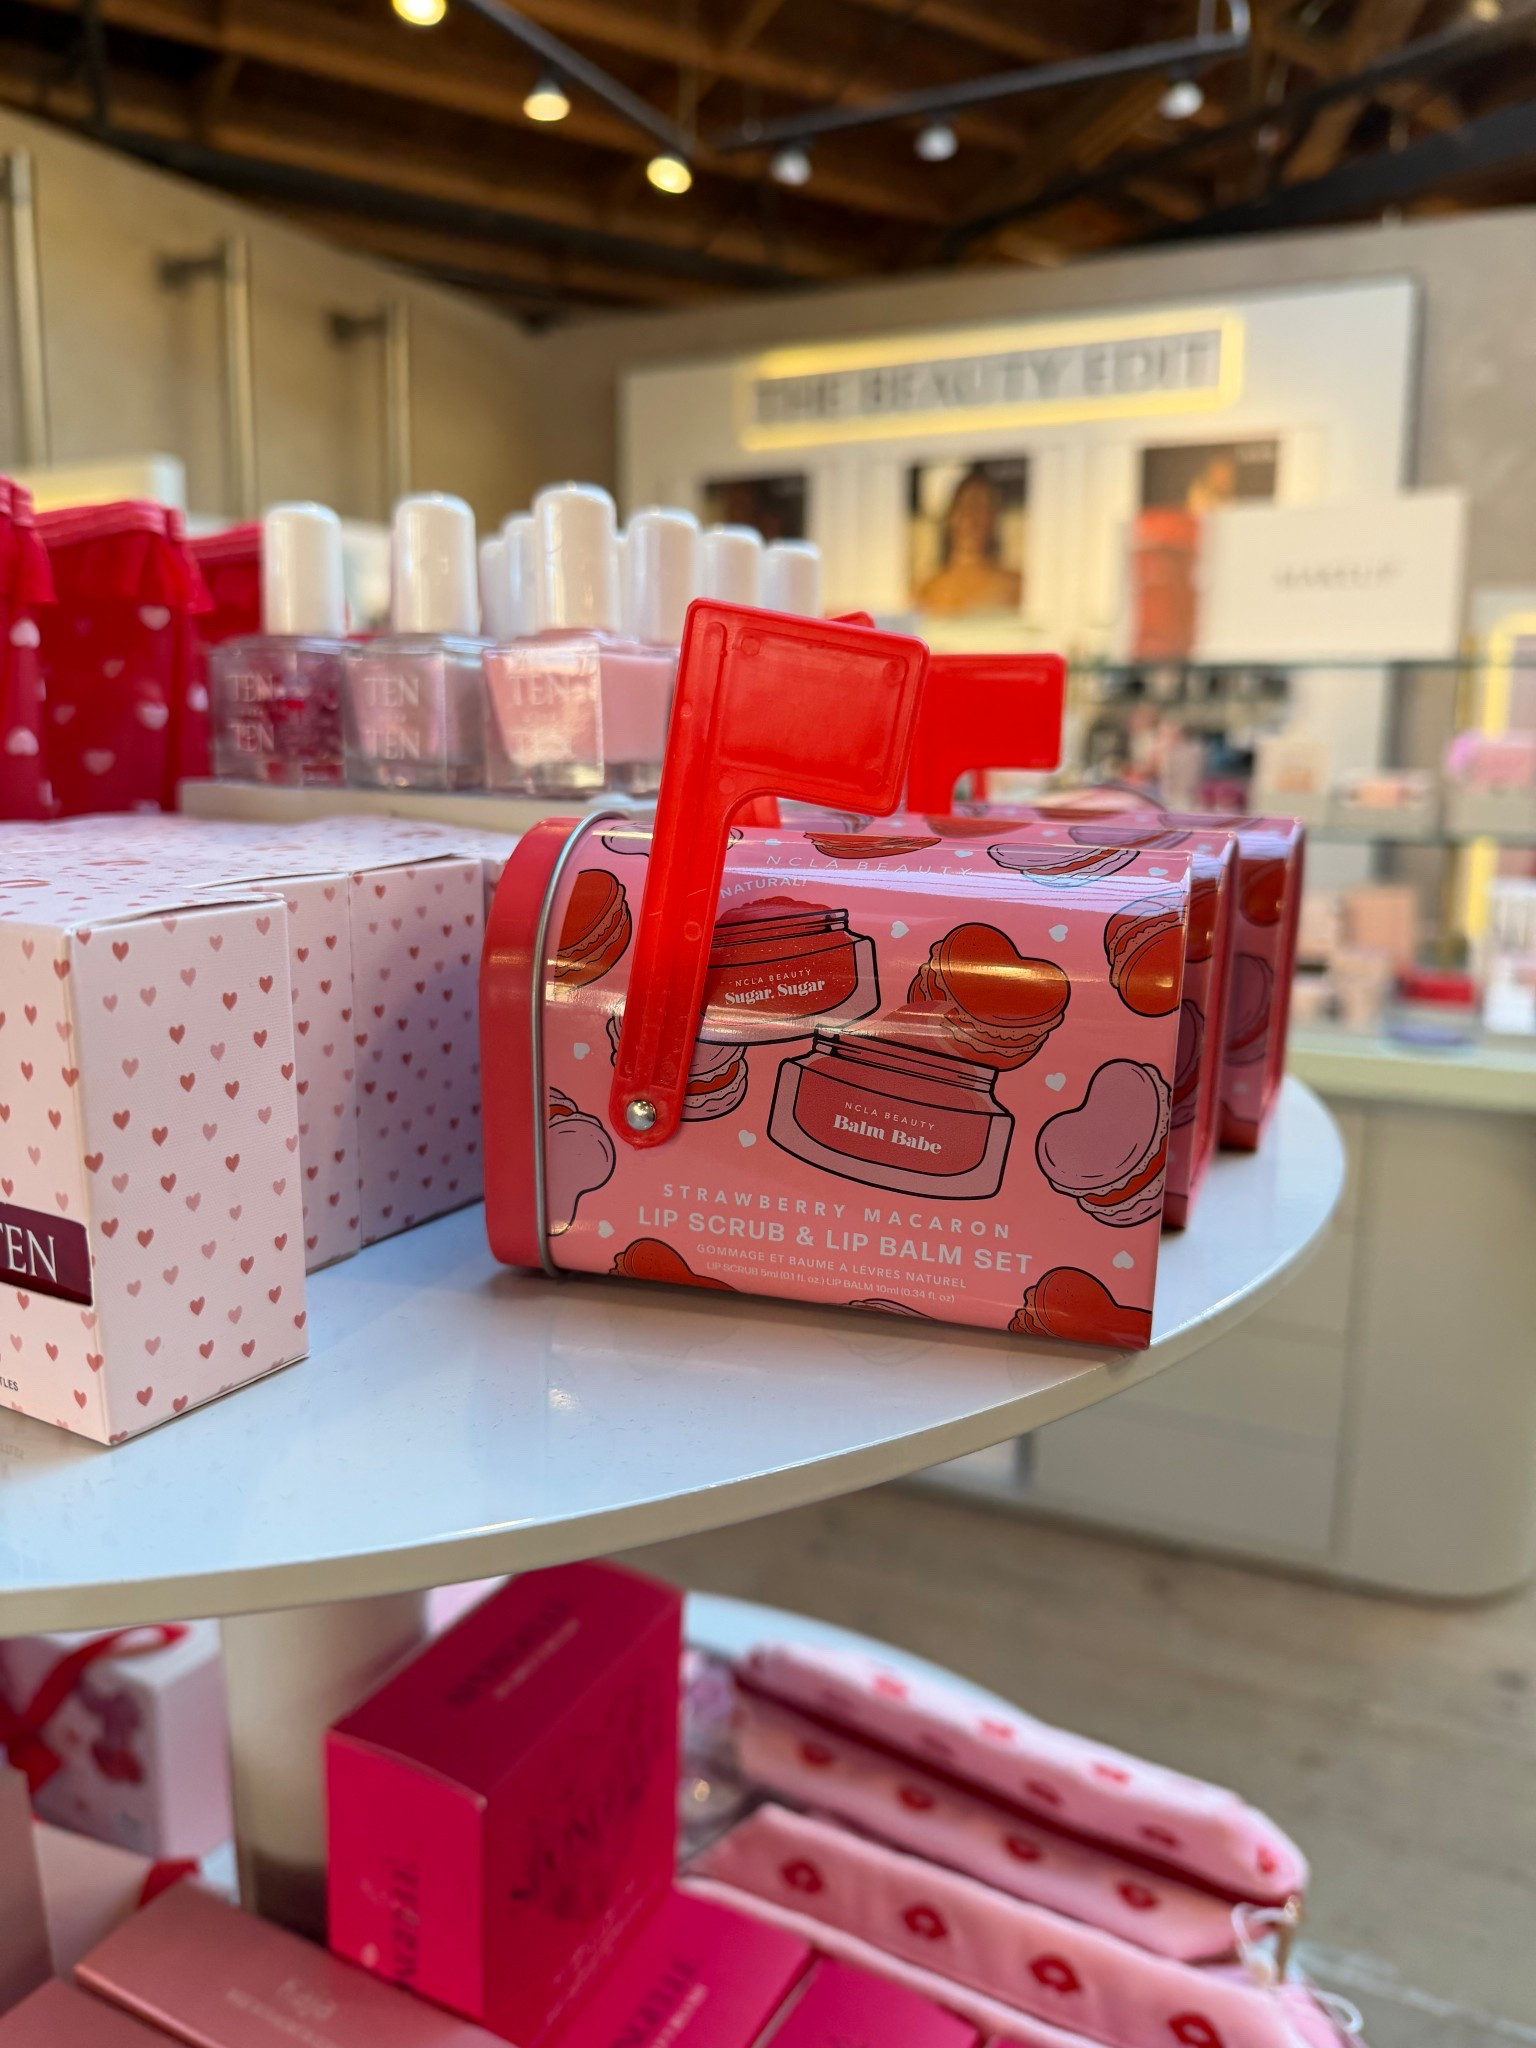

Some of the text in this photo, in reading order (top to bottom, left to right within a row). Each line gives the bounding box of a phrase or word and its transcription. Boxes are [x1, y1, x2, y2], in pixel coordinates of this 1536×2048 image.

[860, 348, 1072, 415] BEAUTY
[1083, 331, 1218, 396] EDIT
[225, 674, 274, 701] TEN
[363, 677, 420, 708] TEN
[508, 672, 572, 706] TEN
[230, 723, 275, 752] TEN
[366, 729, 420, 760] TEN
[765, 854, 974, 876] NCLA BEAUTY
[720, 876, 809, 899] NATURAL!
[735, 968, 812, 987] NCLA BEAUTY
[777, 980, 826, 997] Sugar
[844, 1101, 935, 1131] NCLA BEAUTY
[833, 1113, 942, 1154] Balm Babe
[663, 1183, 1009, 1239] STRAWBERRY MACARON
[0, 1222, 58, 1284] EN
[639, 1206, 1033, 1274] LIP SCRUB & LIP BALM SET
[696, 1243, 765, 1261] GOMMAGE
[769, 1253, 784, 1263] ET
[789, 1256, 835, 1271] BAUME
[905, 1271, 967, 1289] NATUREL
[706, 1261, 721, 1271] LIP
[722, 1263, 758, 1276] SCRUB
[760, 1268, 779, 1279] 5ml
[826, 1277, 842, 1287] LIP
[843, 1279, 874, 1292] BALM
[875, 1284, 899, 1295] 10ml
[901, 1287, 925, 1299] (0.34
